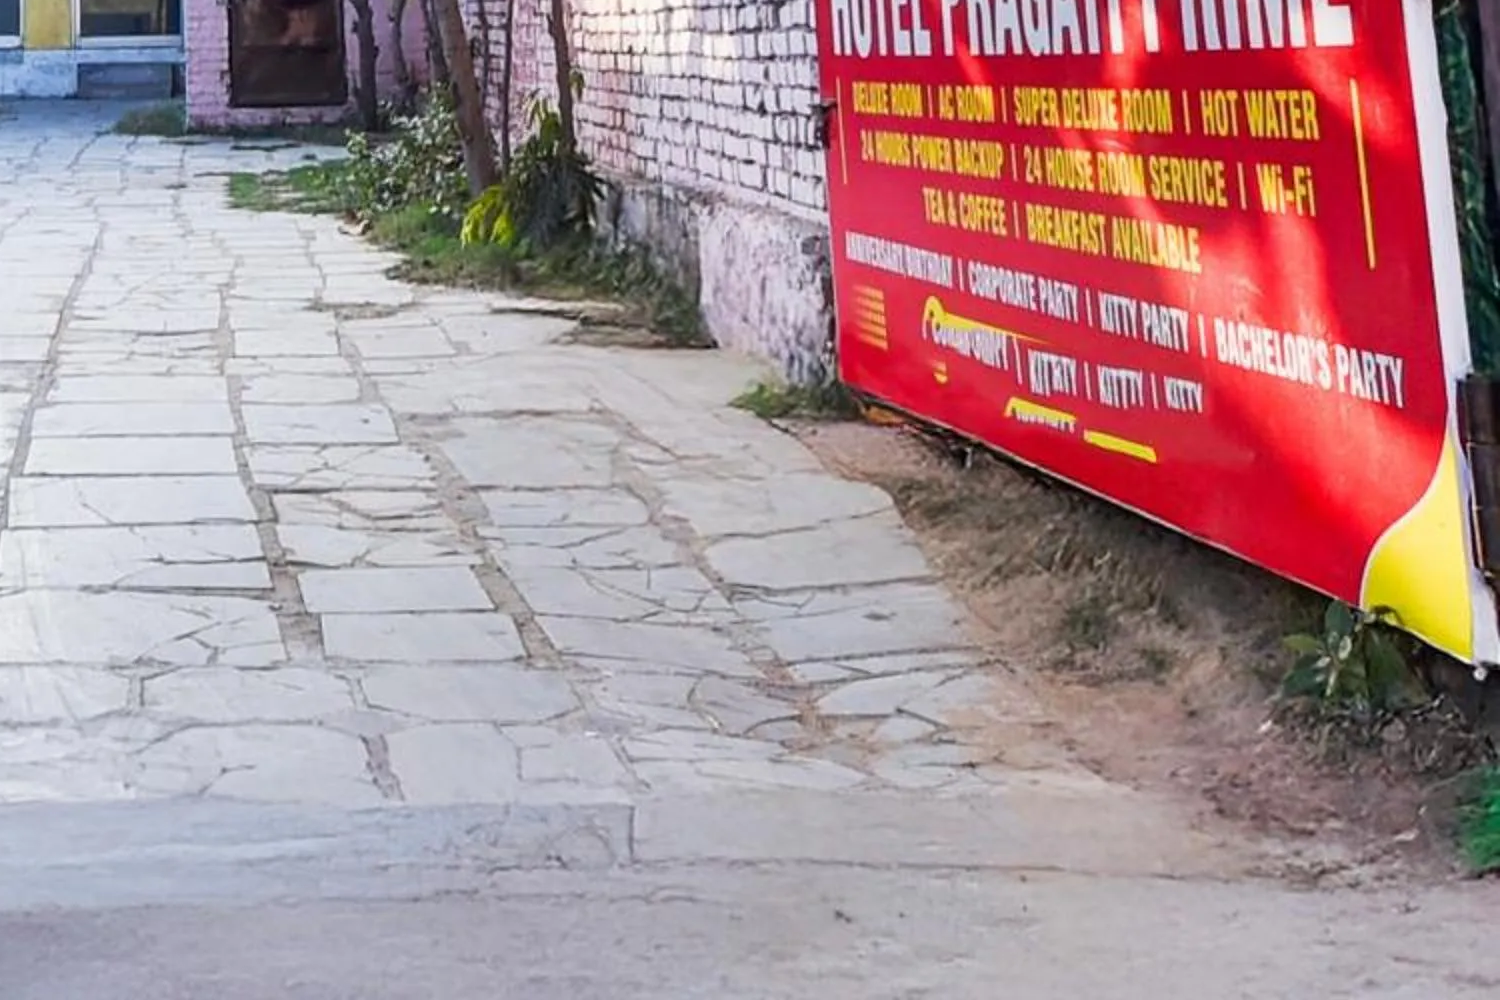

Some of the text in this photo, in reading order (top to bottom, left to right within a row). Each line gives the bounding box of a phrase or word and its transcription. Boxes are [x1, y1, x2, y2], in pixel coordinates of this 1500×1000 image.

[955, 85, 995, 123] ROOM
[1014, 87, 1060, 127] SUPER
[1061, 88, 1119, 131] DELUXE
[1120, 89, 1174, 134] ROOM
[1200, 90, 1238, 137] HOT
[1244, 90, 1320, 141] WATER
[861, 129, 874, 162] 24
[911, 133, 952, 174] POWER
[953, 138, 1004, 180] BACKUP
[1023, 145, 1043, 185] 24
[1045, 147, 1096, 193] HOUSE
[1097, 151, 1147, 198] ROOM
[1149, 155, 1229, 208] SERVICE
[1256, 162, 1317, 218] Wi-Fi
[922, 187, 945, 224] TEA
[959, 192, 1008, 237] COFFEE
[1025, 202, 1107, 258] BREAKFAST
[1111, 215, 1202, 275] AVAILABLE
[967, 260, 1038, 311] CORPORATE
[1037, 276, 1080, 324] PARTY
[1097, 291, 1140, 339] KITTY
[1140, 301, 1190, 353] PARTY
[1213, 315, 1333, 391] BACHELOR'S
[1334, 342, 1405, 409] PARTY
